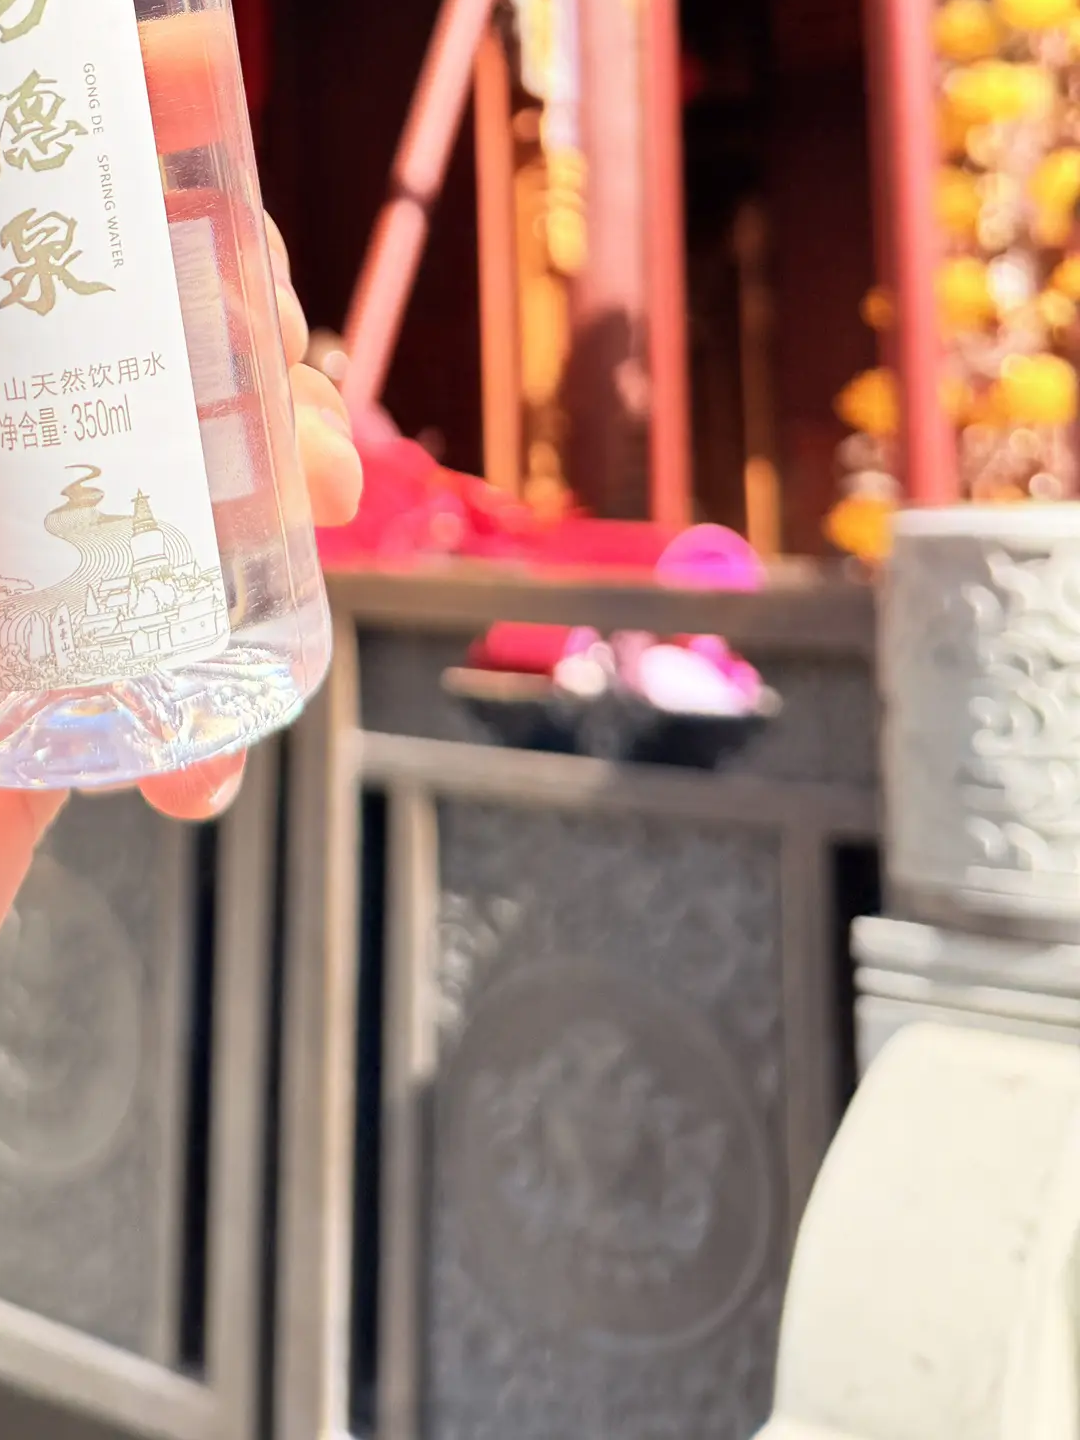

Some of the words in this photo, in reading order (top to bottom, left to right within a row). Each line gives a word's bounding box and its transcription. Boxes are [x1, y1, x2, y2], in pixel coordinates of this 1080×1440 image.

[83, 62, 101, 110] GONG
[91, 114, 105, 135] DE
[96, 154, 117, 211] SPRING
[107, 213, 124, 268] WATER
